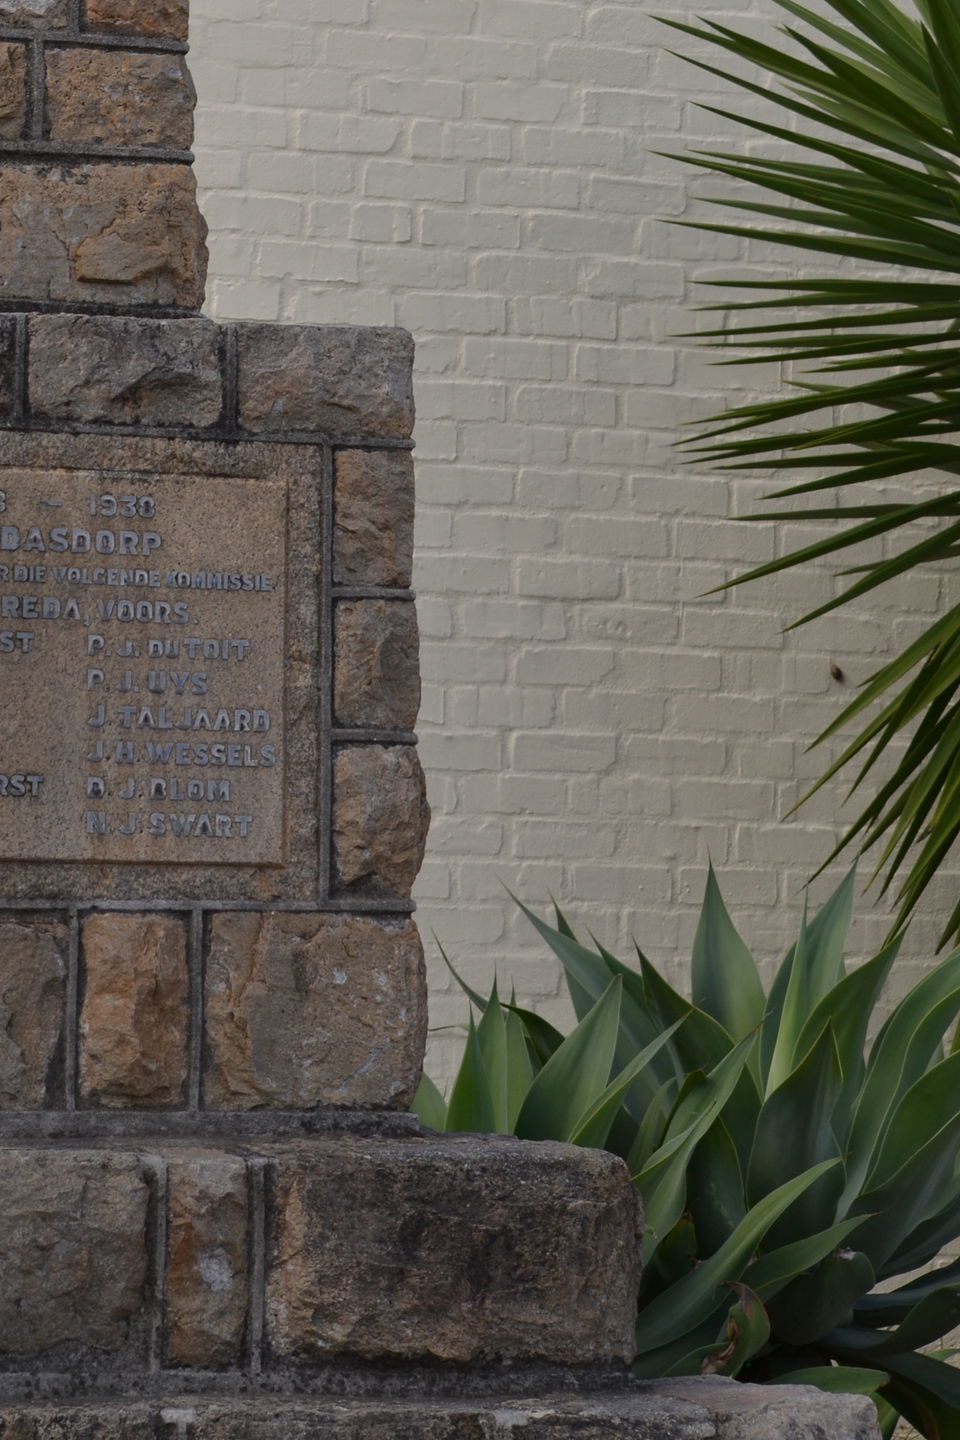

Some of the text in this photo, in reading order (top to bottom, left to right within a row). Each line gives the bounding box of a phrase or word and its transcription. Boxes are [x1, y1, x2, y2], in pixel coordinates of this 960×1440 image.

[88, 493, 157, 519] 1938
[14, 565, 47, 583] DIE
[148, 671, 208, 695] UYS
[118, 706, 270, 732] TALJAARD
[145, 743, 277, 767] WESSELS
[150, 778, 232, 802] BLOM
[149, 812, 253, 838] SWART
